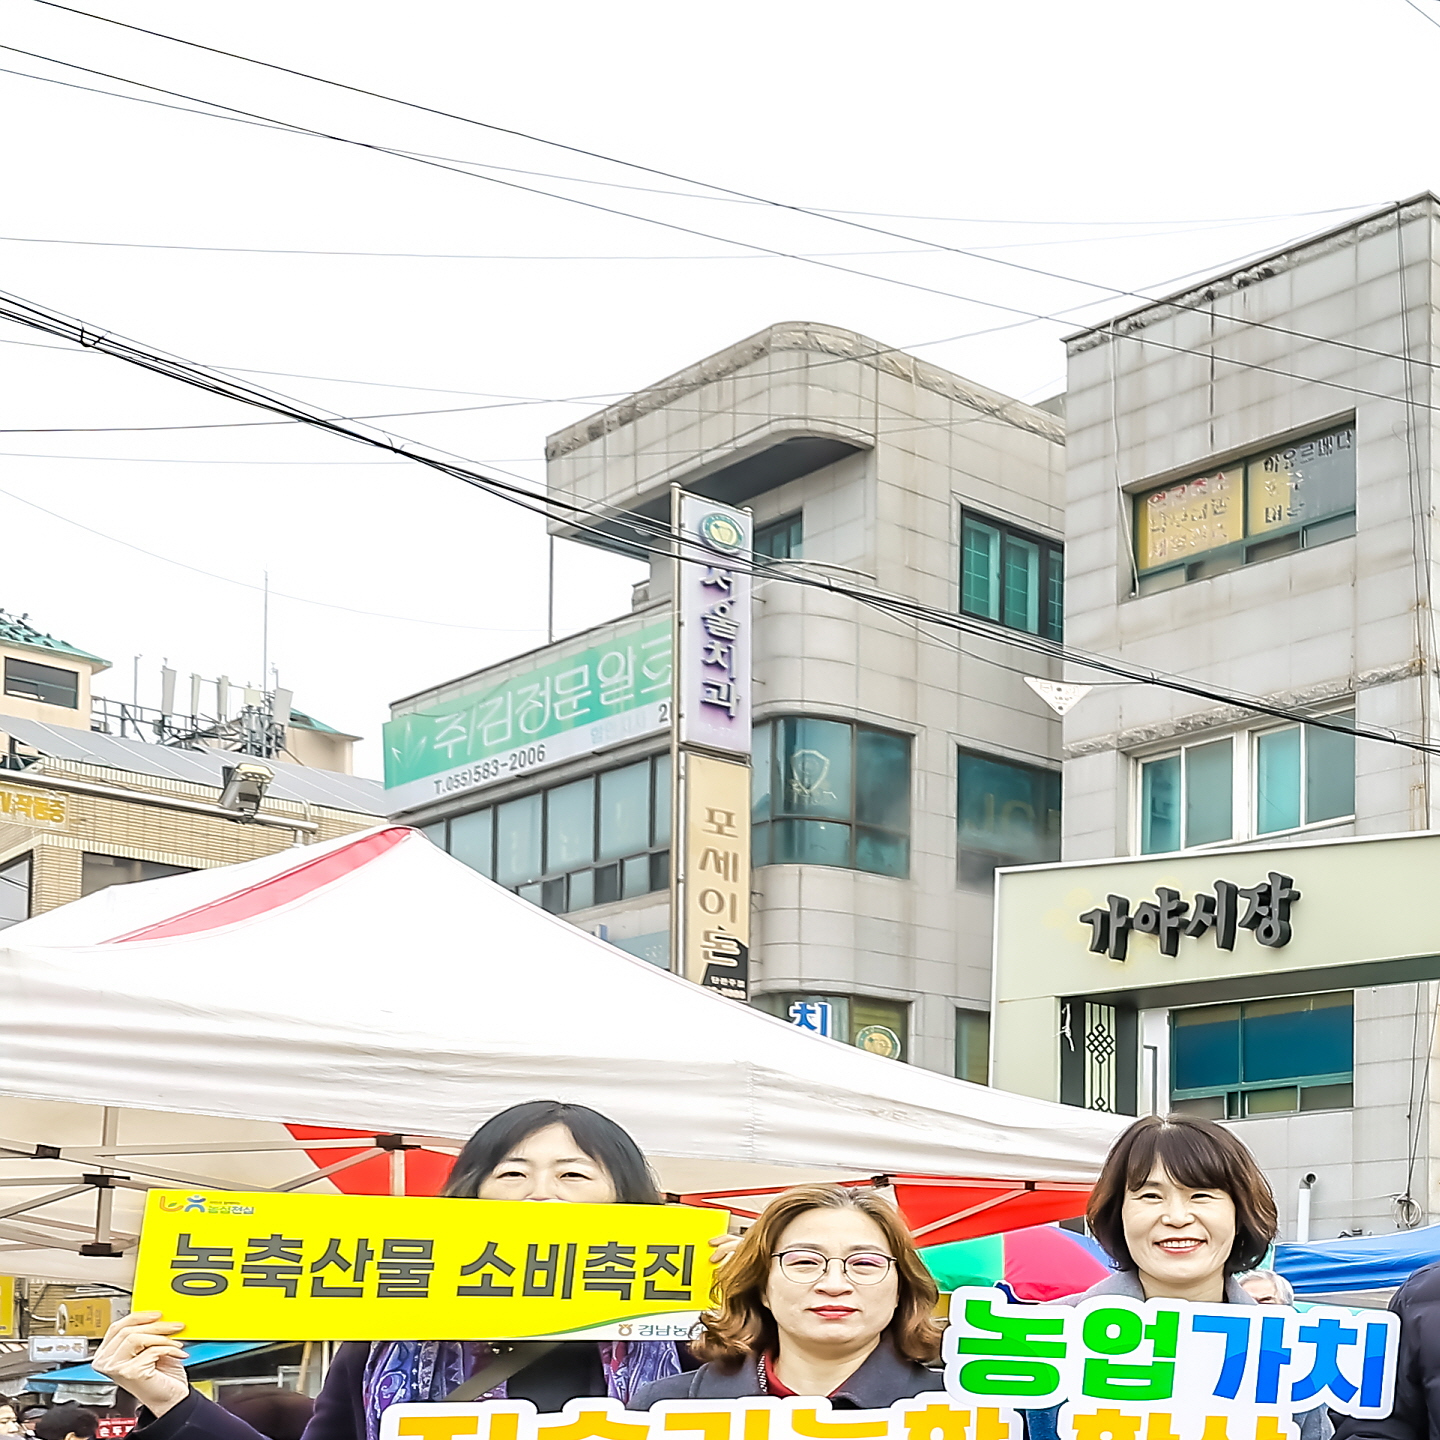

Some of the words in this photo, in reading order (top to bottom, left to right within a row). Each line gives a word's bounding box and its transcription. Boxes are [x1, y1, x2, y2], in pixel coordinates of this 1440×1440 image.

[698, 806, 742, 967] 포세이돈
[1080, 871, 1301, 962] 가야시장
[170, 1233, 435, 1298] 농축산물
[456, 1241, 696, 1301] 소비촉진
